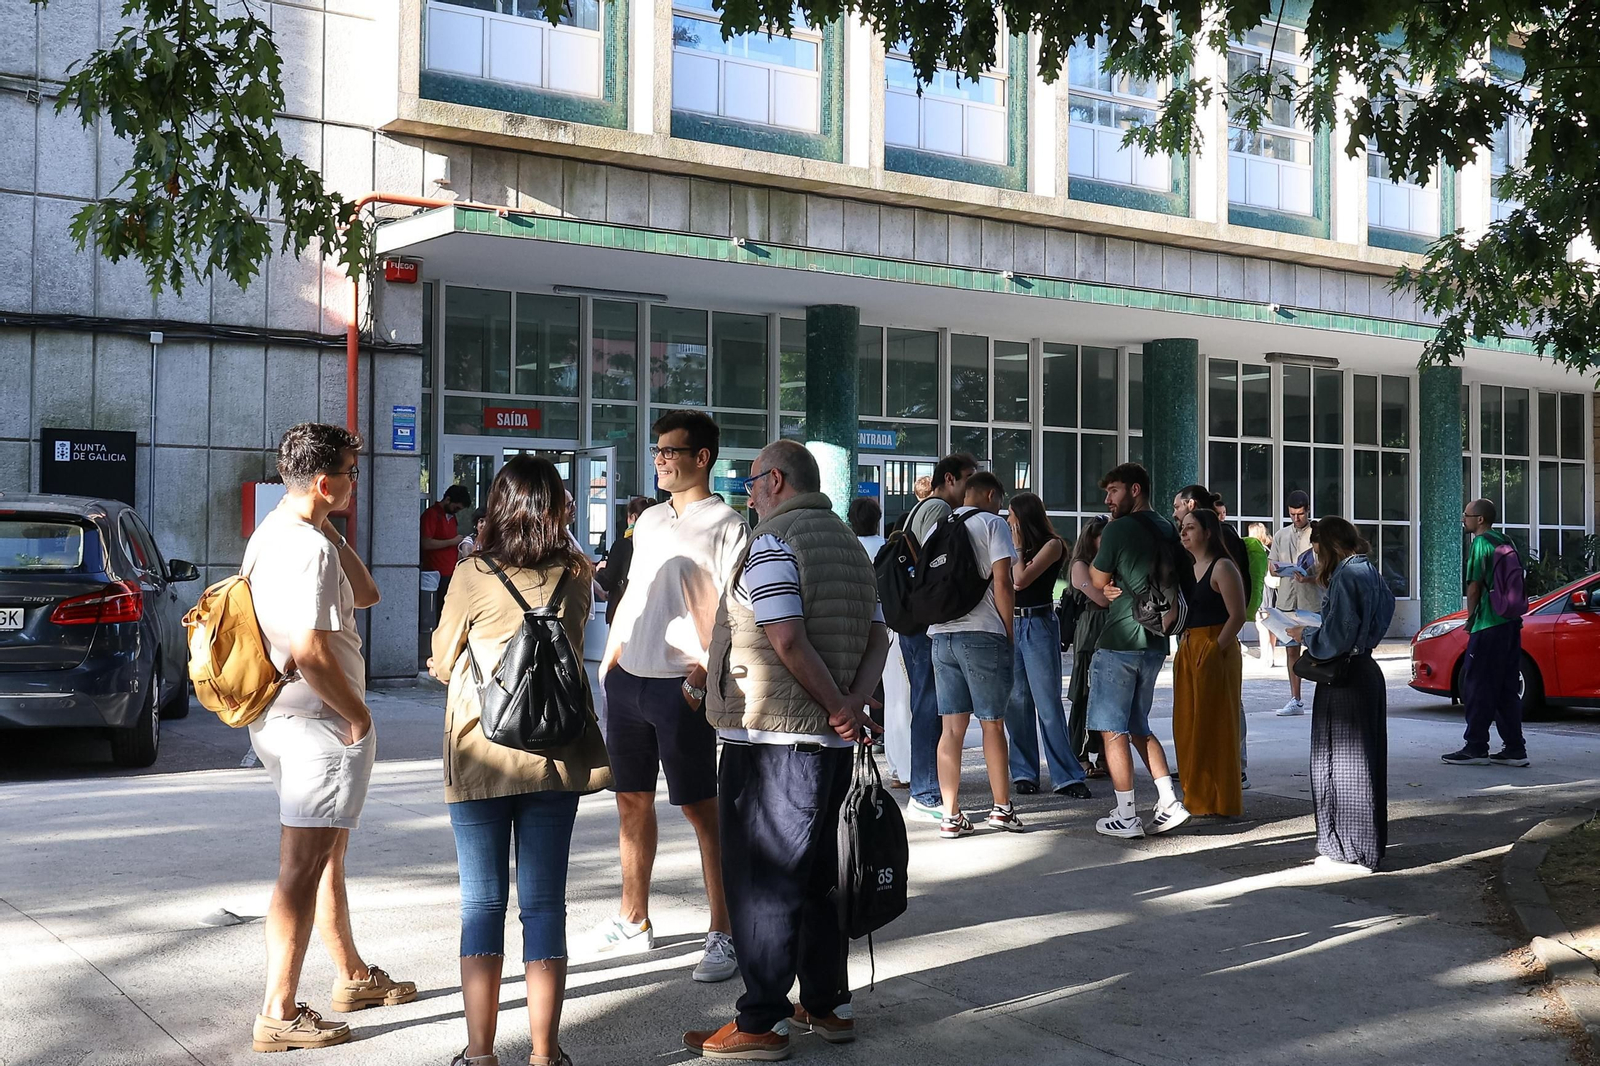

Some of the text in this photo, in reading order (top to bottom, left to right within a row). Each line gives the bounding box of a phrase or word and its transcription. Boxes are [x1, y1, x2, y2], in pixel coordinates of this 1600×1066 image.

[390, 261, 415, 270] FUEGO
[496, 410, 529, 427] SAÍDA
[73, 443, 107, 452] XUNTA
[73, 453, 127, 462] DE GALICIA
[0, 610, 19, 626] GK
